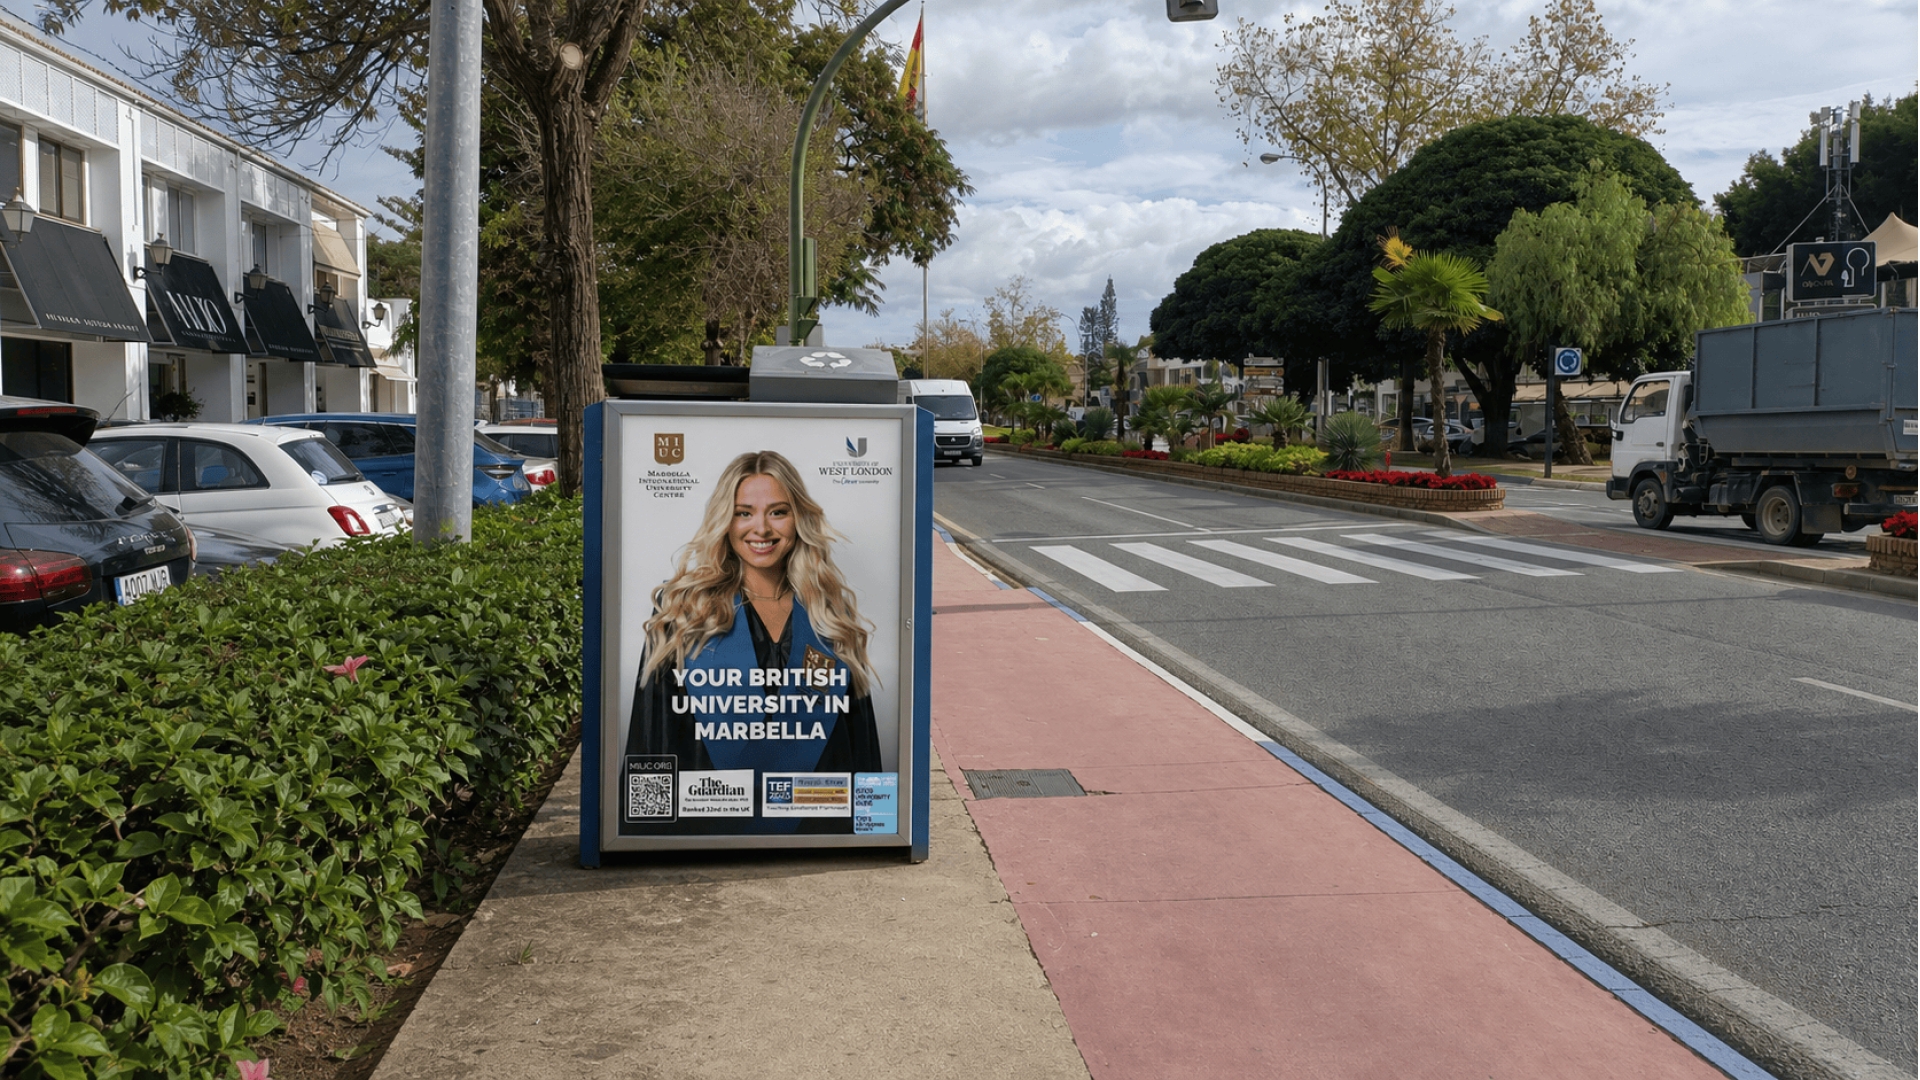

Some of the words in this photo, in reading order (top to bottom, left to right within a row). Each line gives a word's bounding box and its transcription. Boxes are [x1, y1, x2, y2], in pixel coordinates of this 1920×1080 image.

[819, 467, 849, 475] WEST
[851, 467, 892, 475] LONDON
[672, 668, 743, 687] YOUR
[749, 668, 847, 687] BRITISH
[671, 695, 819, 714] UNIVERSITY
[824, 695, 850, 714] IN
[694, 722, 827, 740] MARBELLA
[699, 776, 723, 788] The
[768, 781, 791, 791] TEF
[688, 784, 745, 796] Guardian
